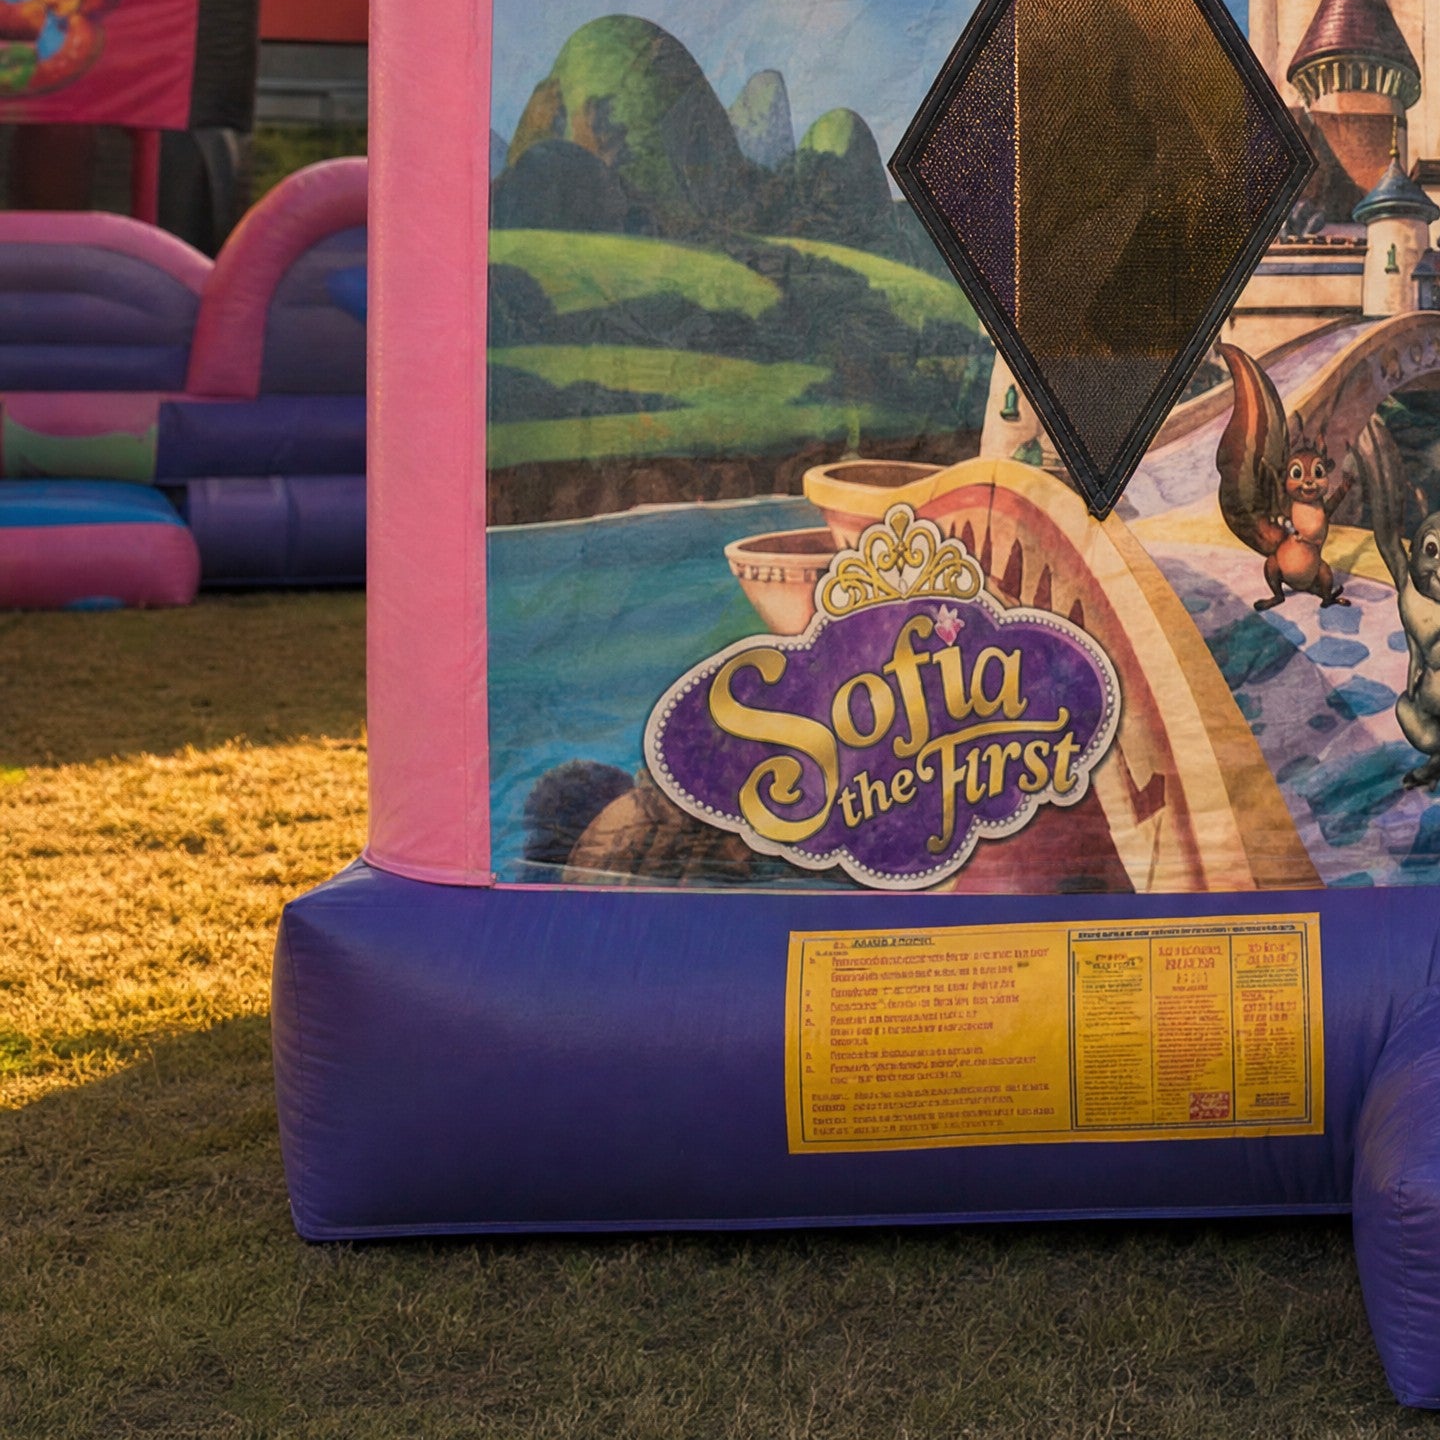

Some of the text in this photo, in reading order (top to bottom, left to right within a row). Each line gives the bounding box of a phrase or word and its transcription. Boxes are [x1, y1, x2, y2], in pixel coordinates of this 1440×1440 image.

[708, 610, 1027, 842] Sofia
[837, 706, 1081, 854] the First
